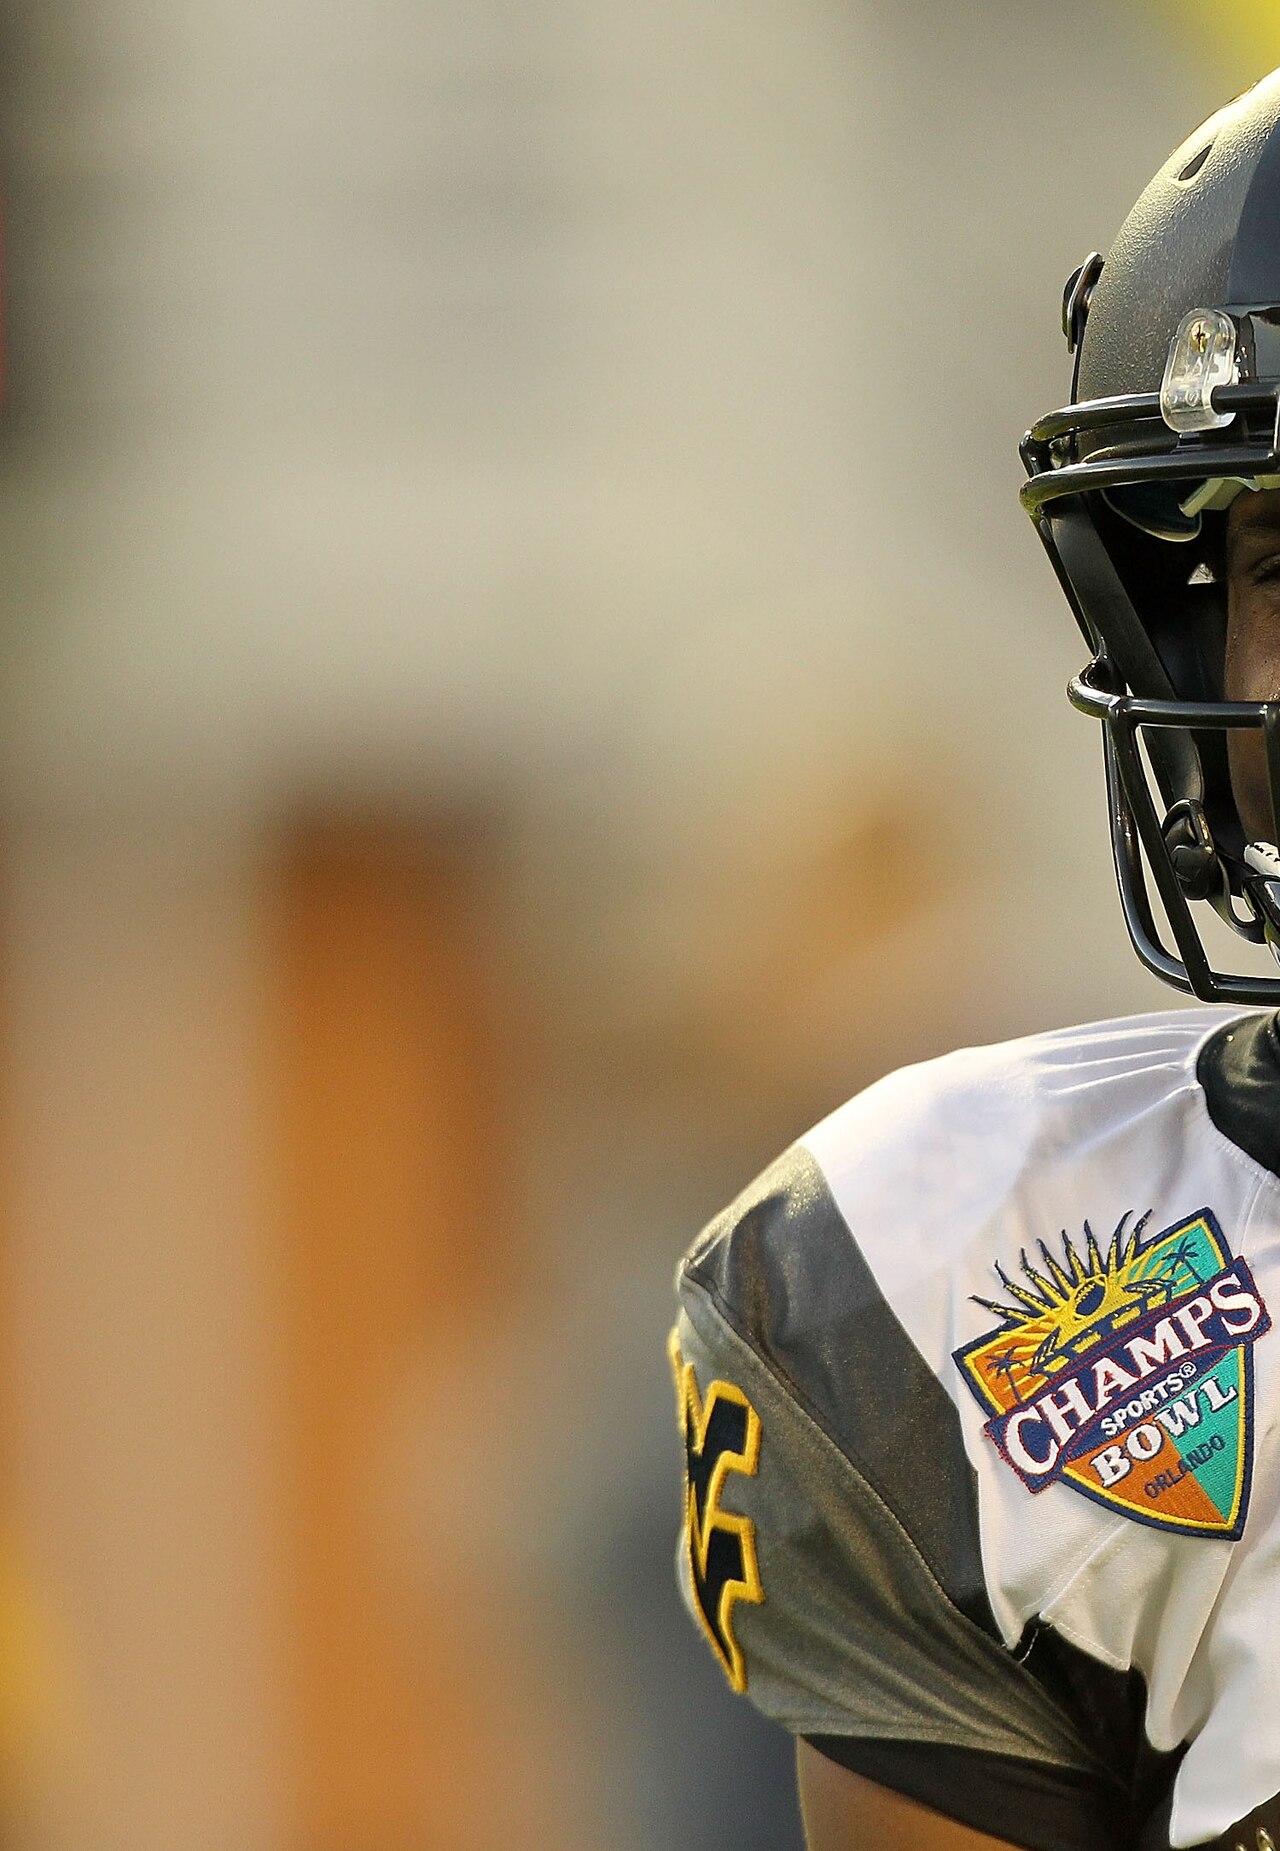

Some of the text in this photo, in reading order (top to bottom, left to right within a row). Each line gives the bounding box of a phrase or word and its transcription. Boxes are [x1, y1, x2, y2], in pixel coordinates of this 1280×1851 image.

[1004, 1273, 1261, 1475] CHAMPS
[1089, 1374, 1239, 1488] BOWL
[1143, 1433, 1226, 1499] ORLANDO
